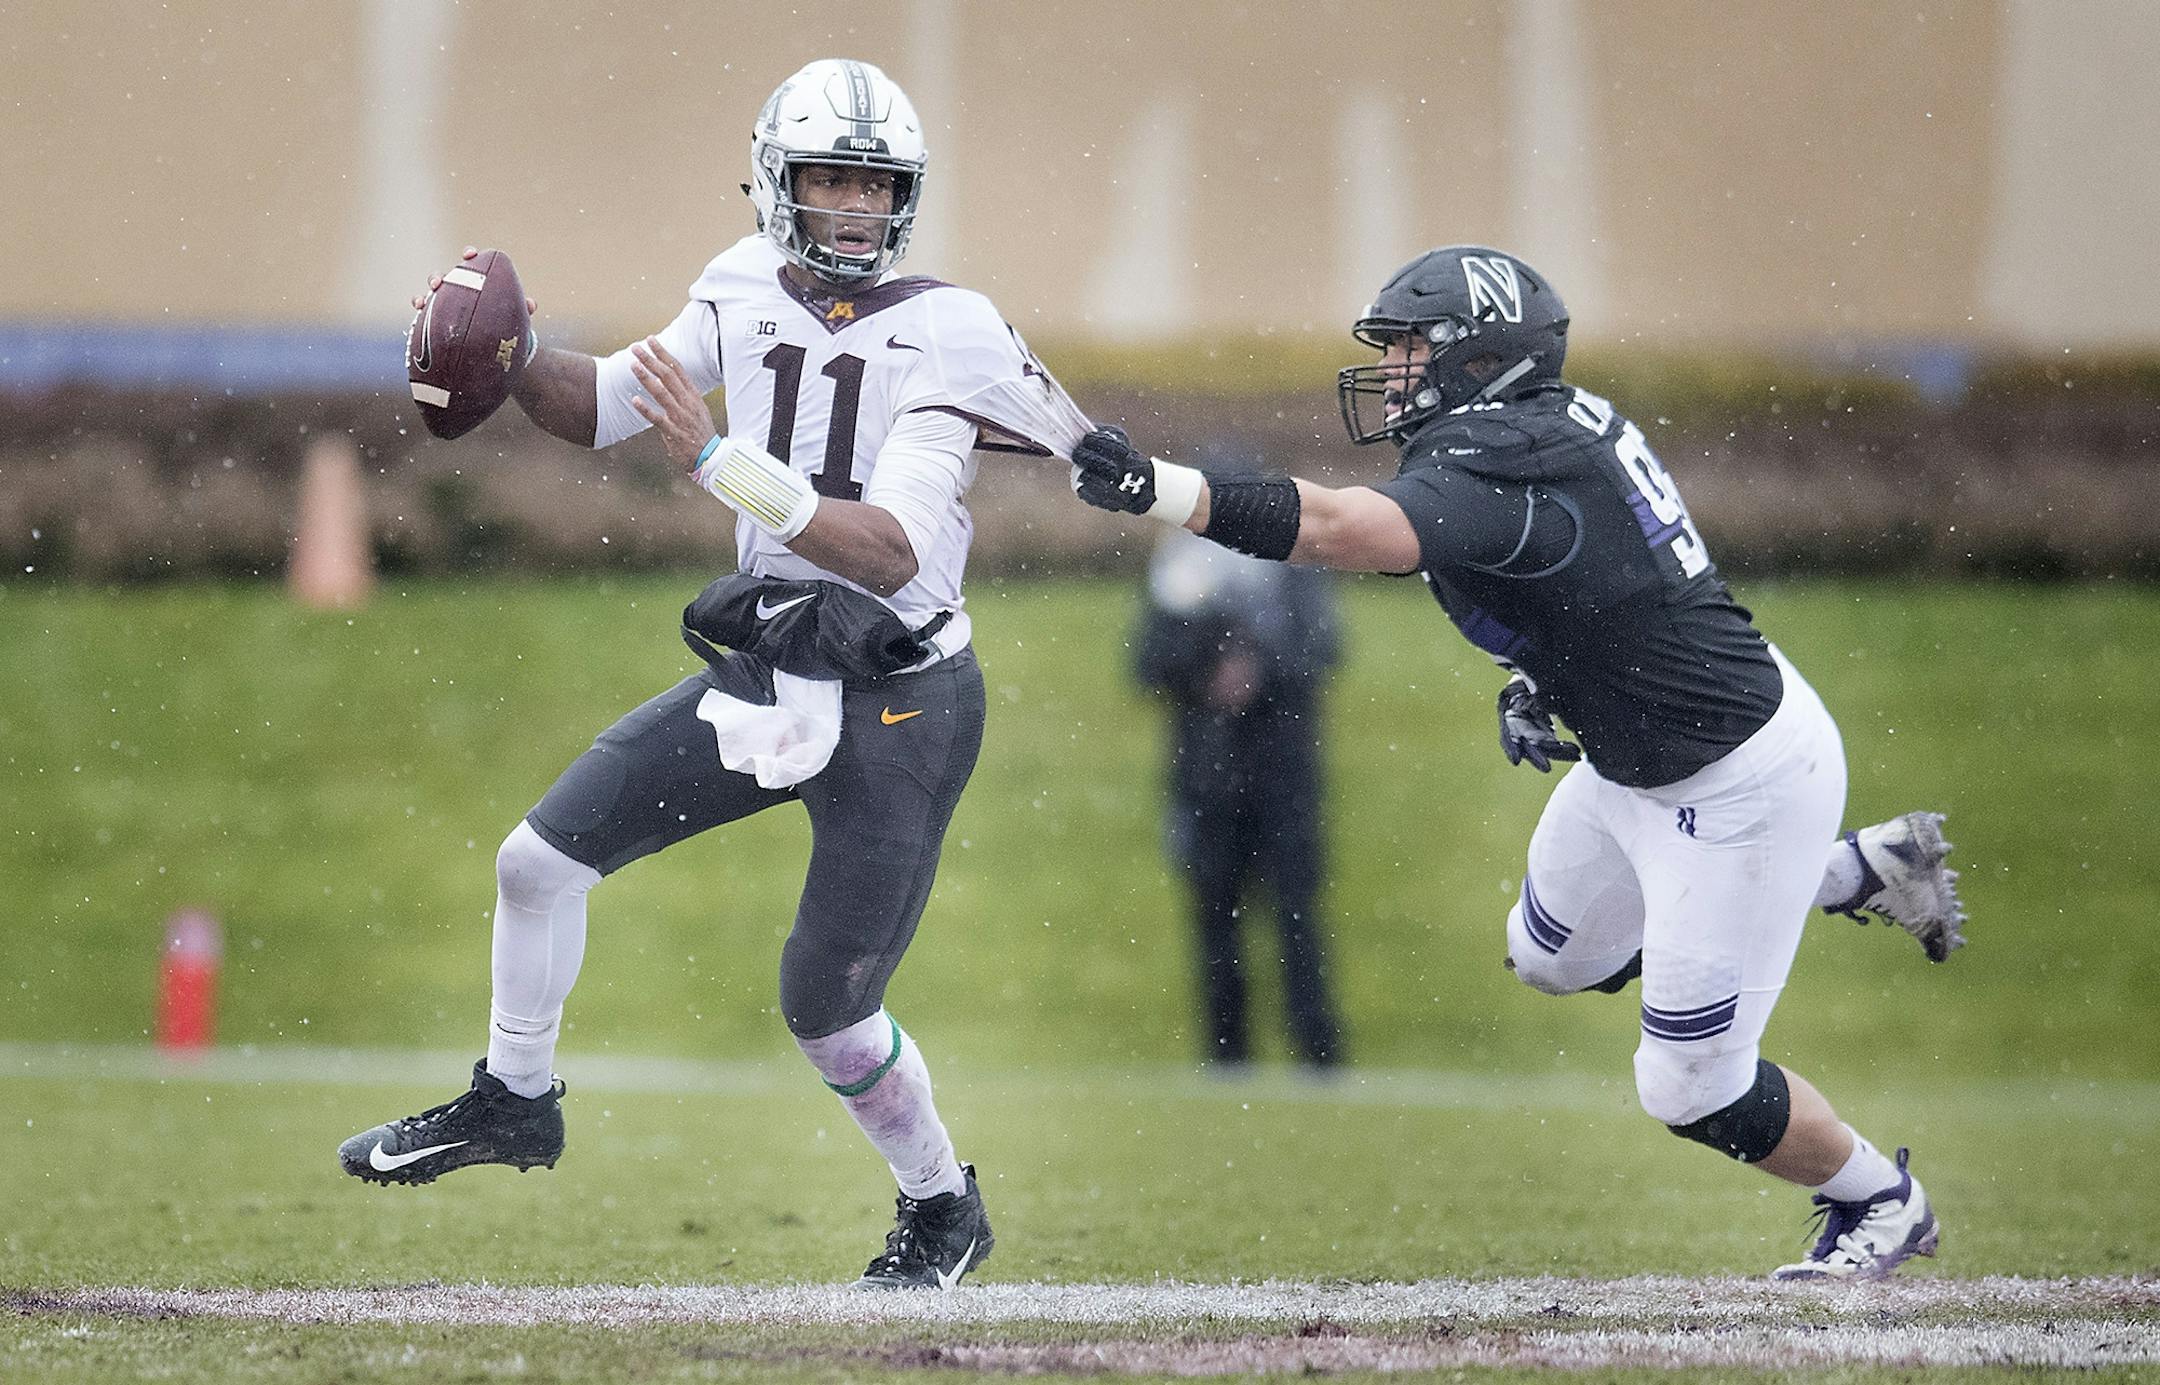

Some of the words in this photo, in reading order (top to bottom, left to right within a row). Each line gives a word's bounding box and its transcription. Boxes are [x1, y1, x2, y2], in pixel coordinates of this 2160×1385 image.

[849, 137, 878, 151] ROW
[1461, 256, 1522, 323] N
[762, 342, 866, 502] 11
